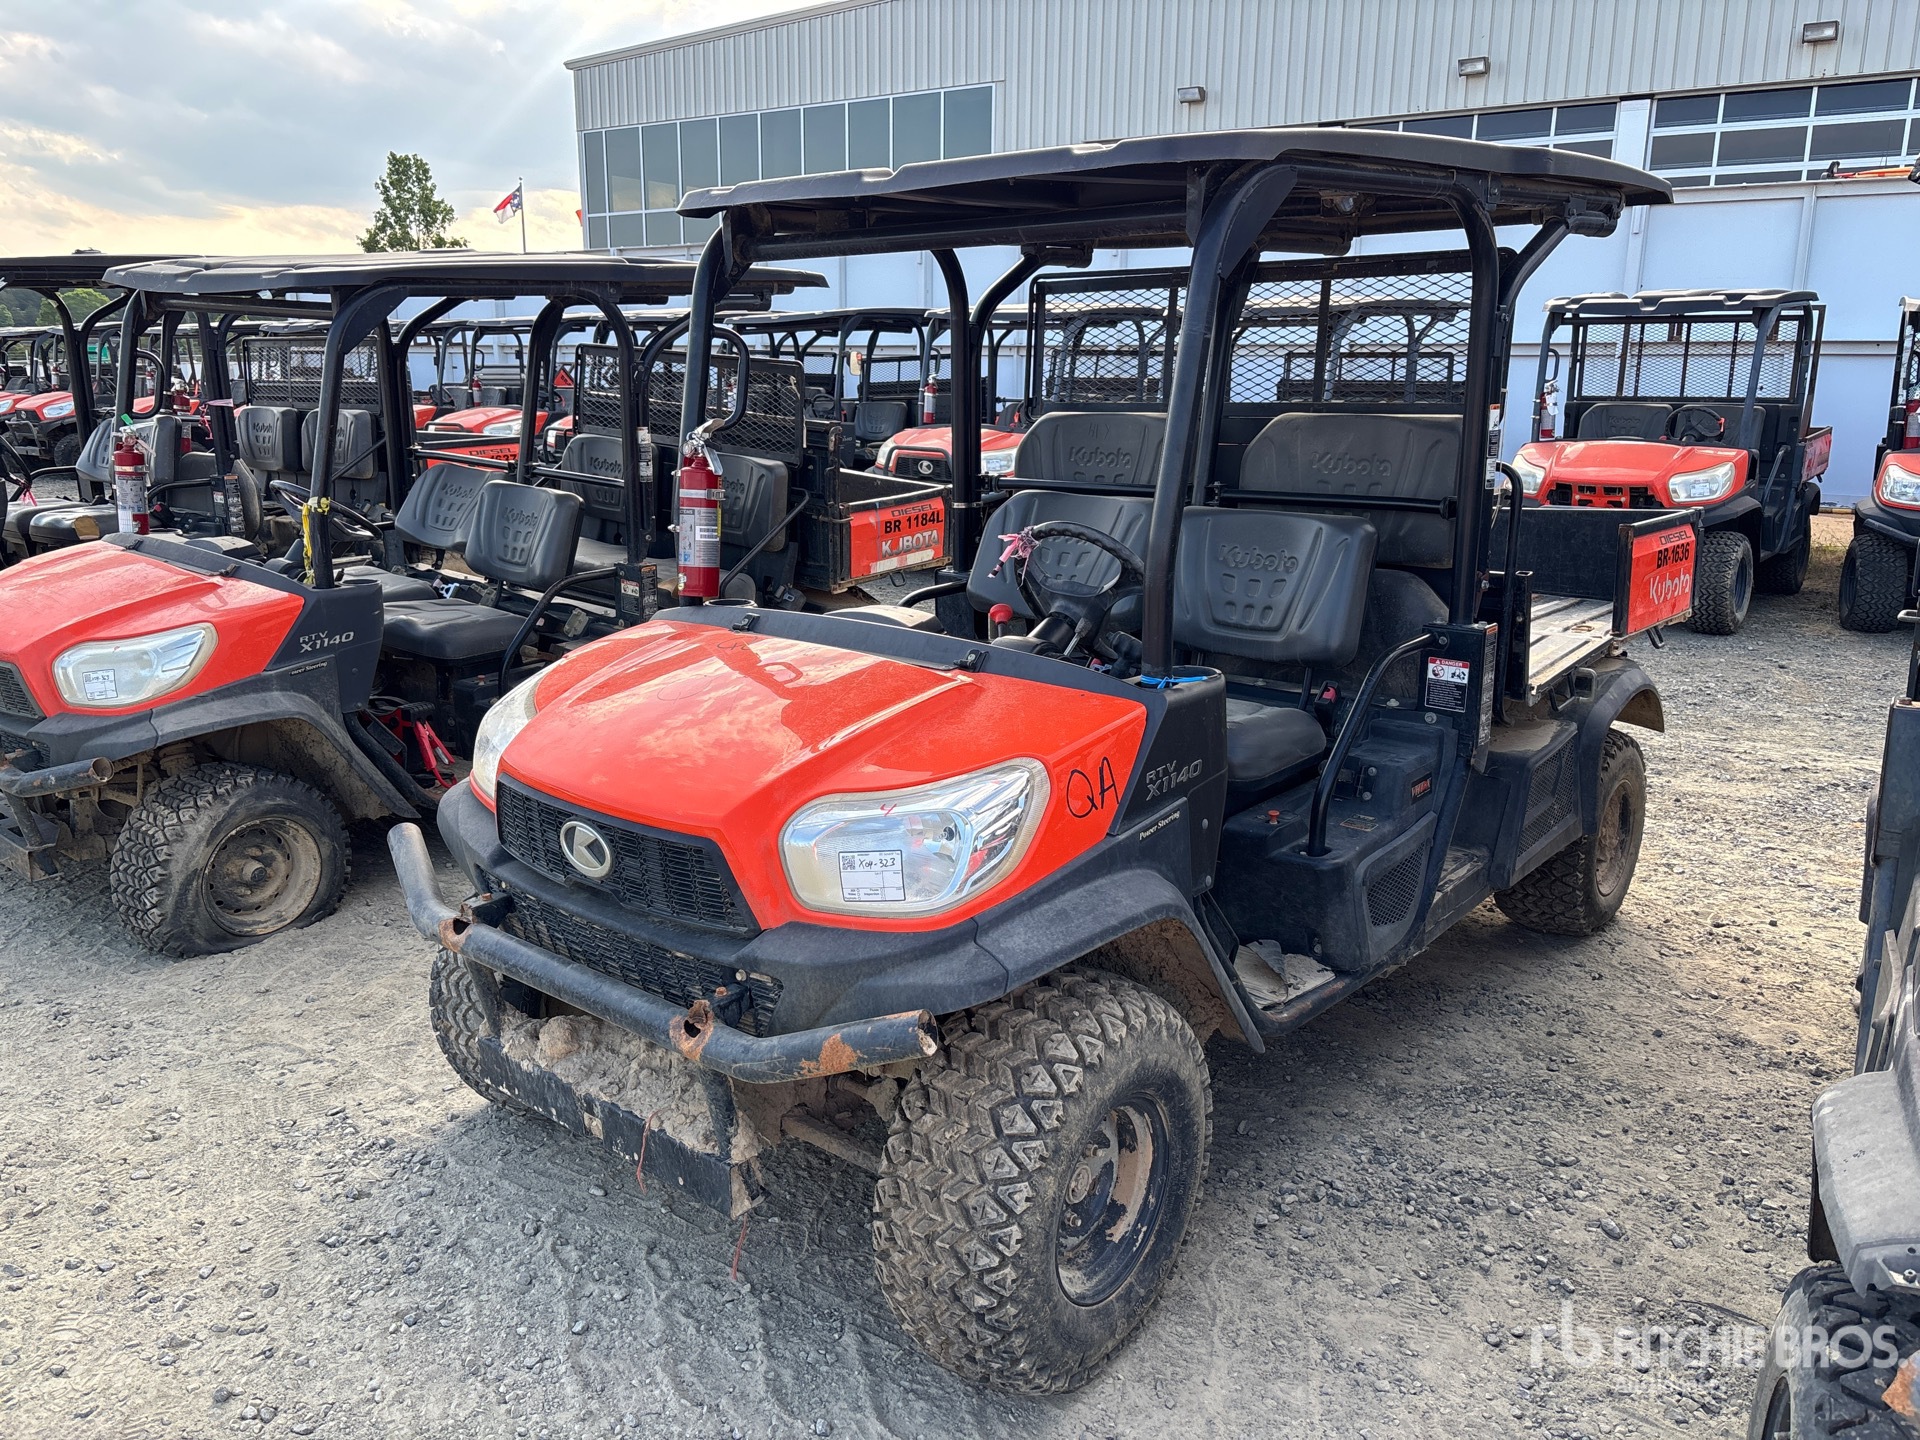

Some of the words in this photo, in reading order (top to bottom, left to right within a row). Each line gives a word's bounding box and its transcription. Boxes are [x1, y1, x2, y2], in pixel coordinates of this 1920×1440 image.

[468, 447, 517, 456] DIESEL
[1069, 446, 1132, 469] Kubota
[1311, 451, 1393, 477] Kubota
[505, 506, 538, 527] Kubota
[884, 519, 902, 534] BR
[906, 510, 944, 530] 1184L
[891, 503, 939, 518] DIESEL
[1659, 529, 1692, 546] DIESEL
[1219, 544, 1299, 575] Kubota
[1656, 542, 1690, 569] BR-1636
[1649, 567, 1691, 605] Kubota
[300, 630, 329, 643] RTV
[300, 631, 355, 654] X1140
[1441, 660, 1463, 668] DANGER
[1146, 760, 1177, 784] RTV
[1146, 759, 1203, 801] X1140
[1066, 756, 1120, 819] QA
[1139, 825, 1158, 841] Power
[1157, 810, 1181, 829] Steering
